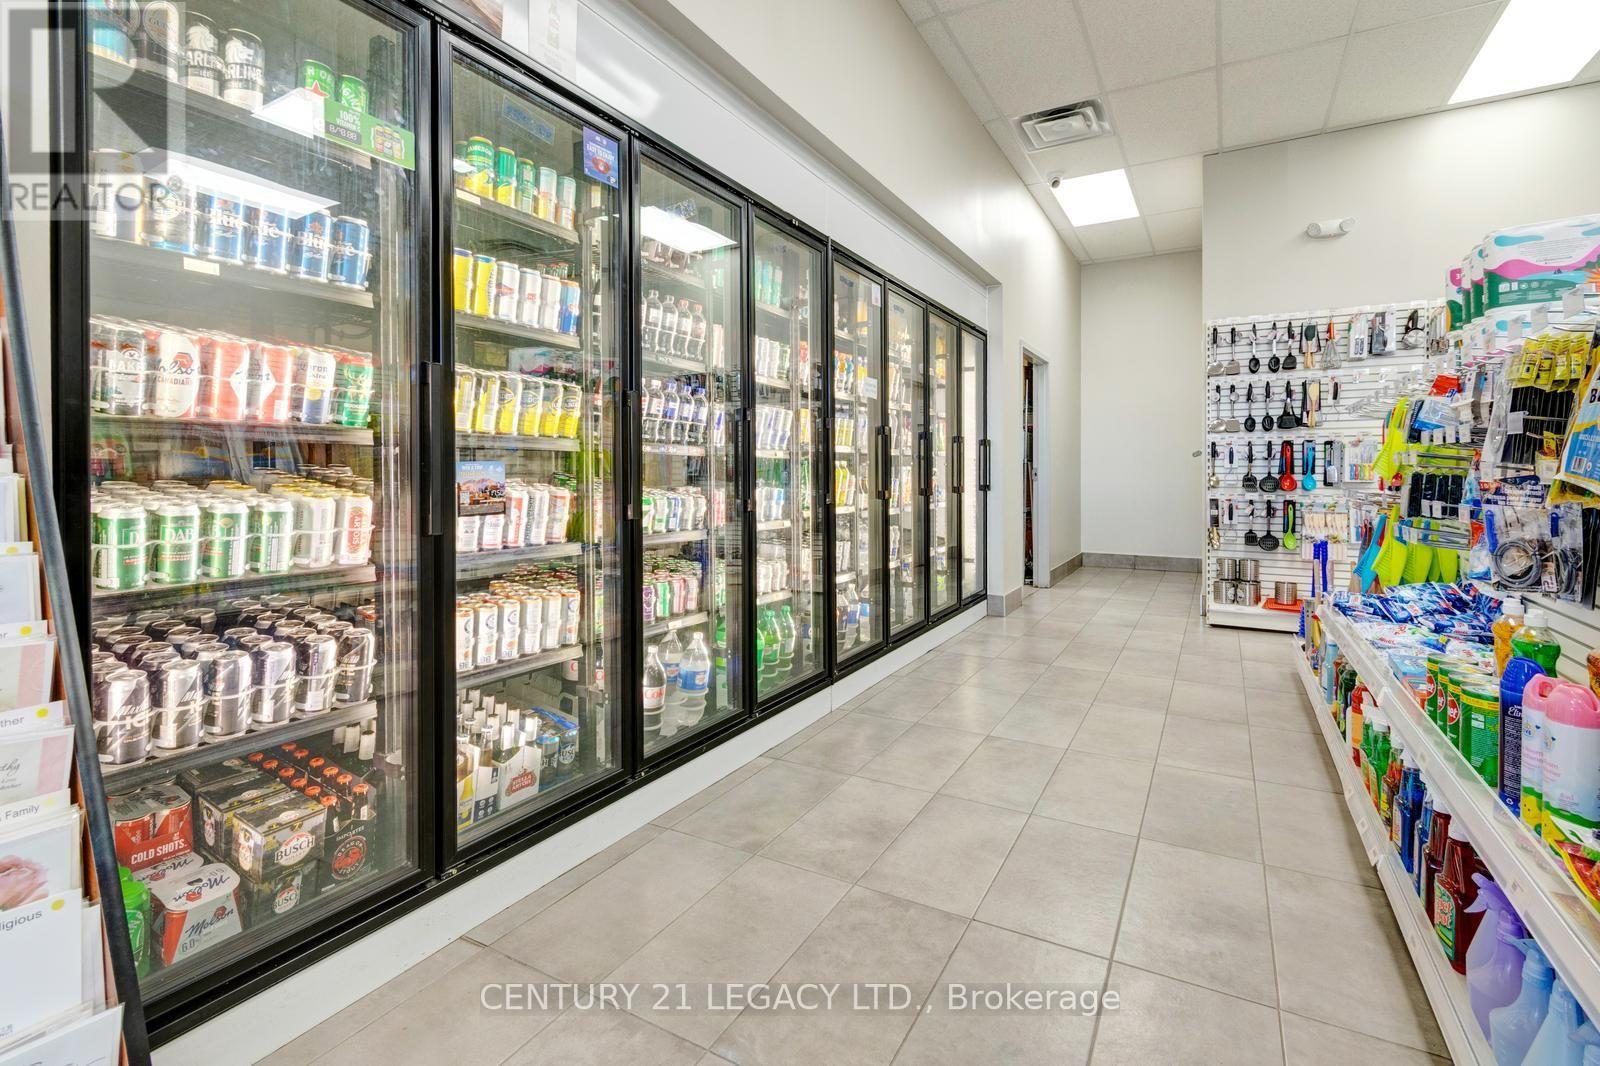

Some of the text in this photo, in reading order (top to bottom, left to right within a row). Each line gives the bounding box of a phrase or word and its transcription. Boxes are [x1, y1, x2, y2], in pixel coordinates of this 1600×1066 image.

[5, 805, 40, 820] Family
[131, 848, 155, 865] COLD
[156, 838, 187, 856] SHOTS.
[275, 835, 316, 862] BUSCH
[184, 908, 235, 937] Molson
